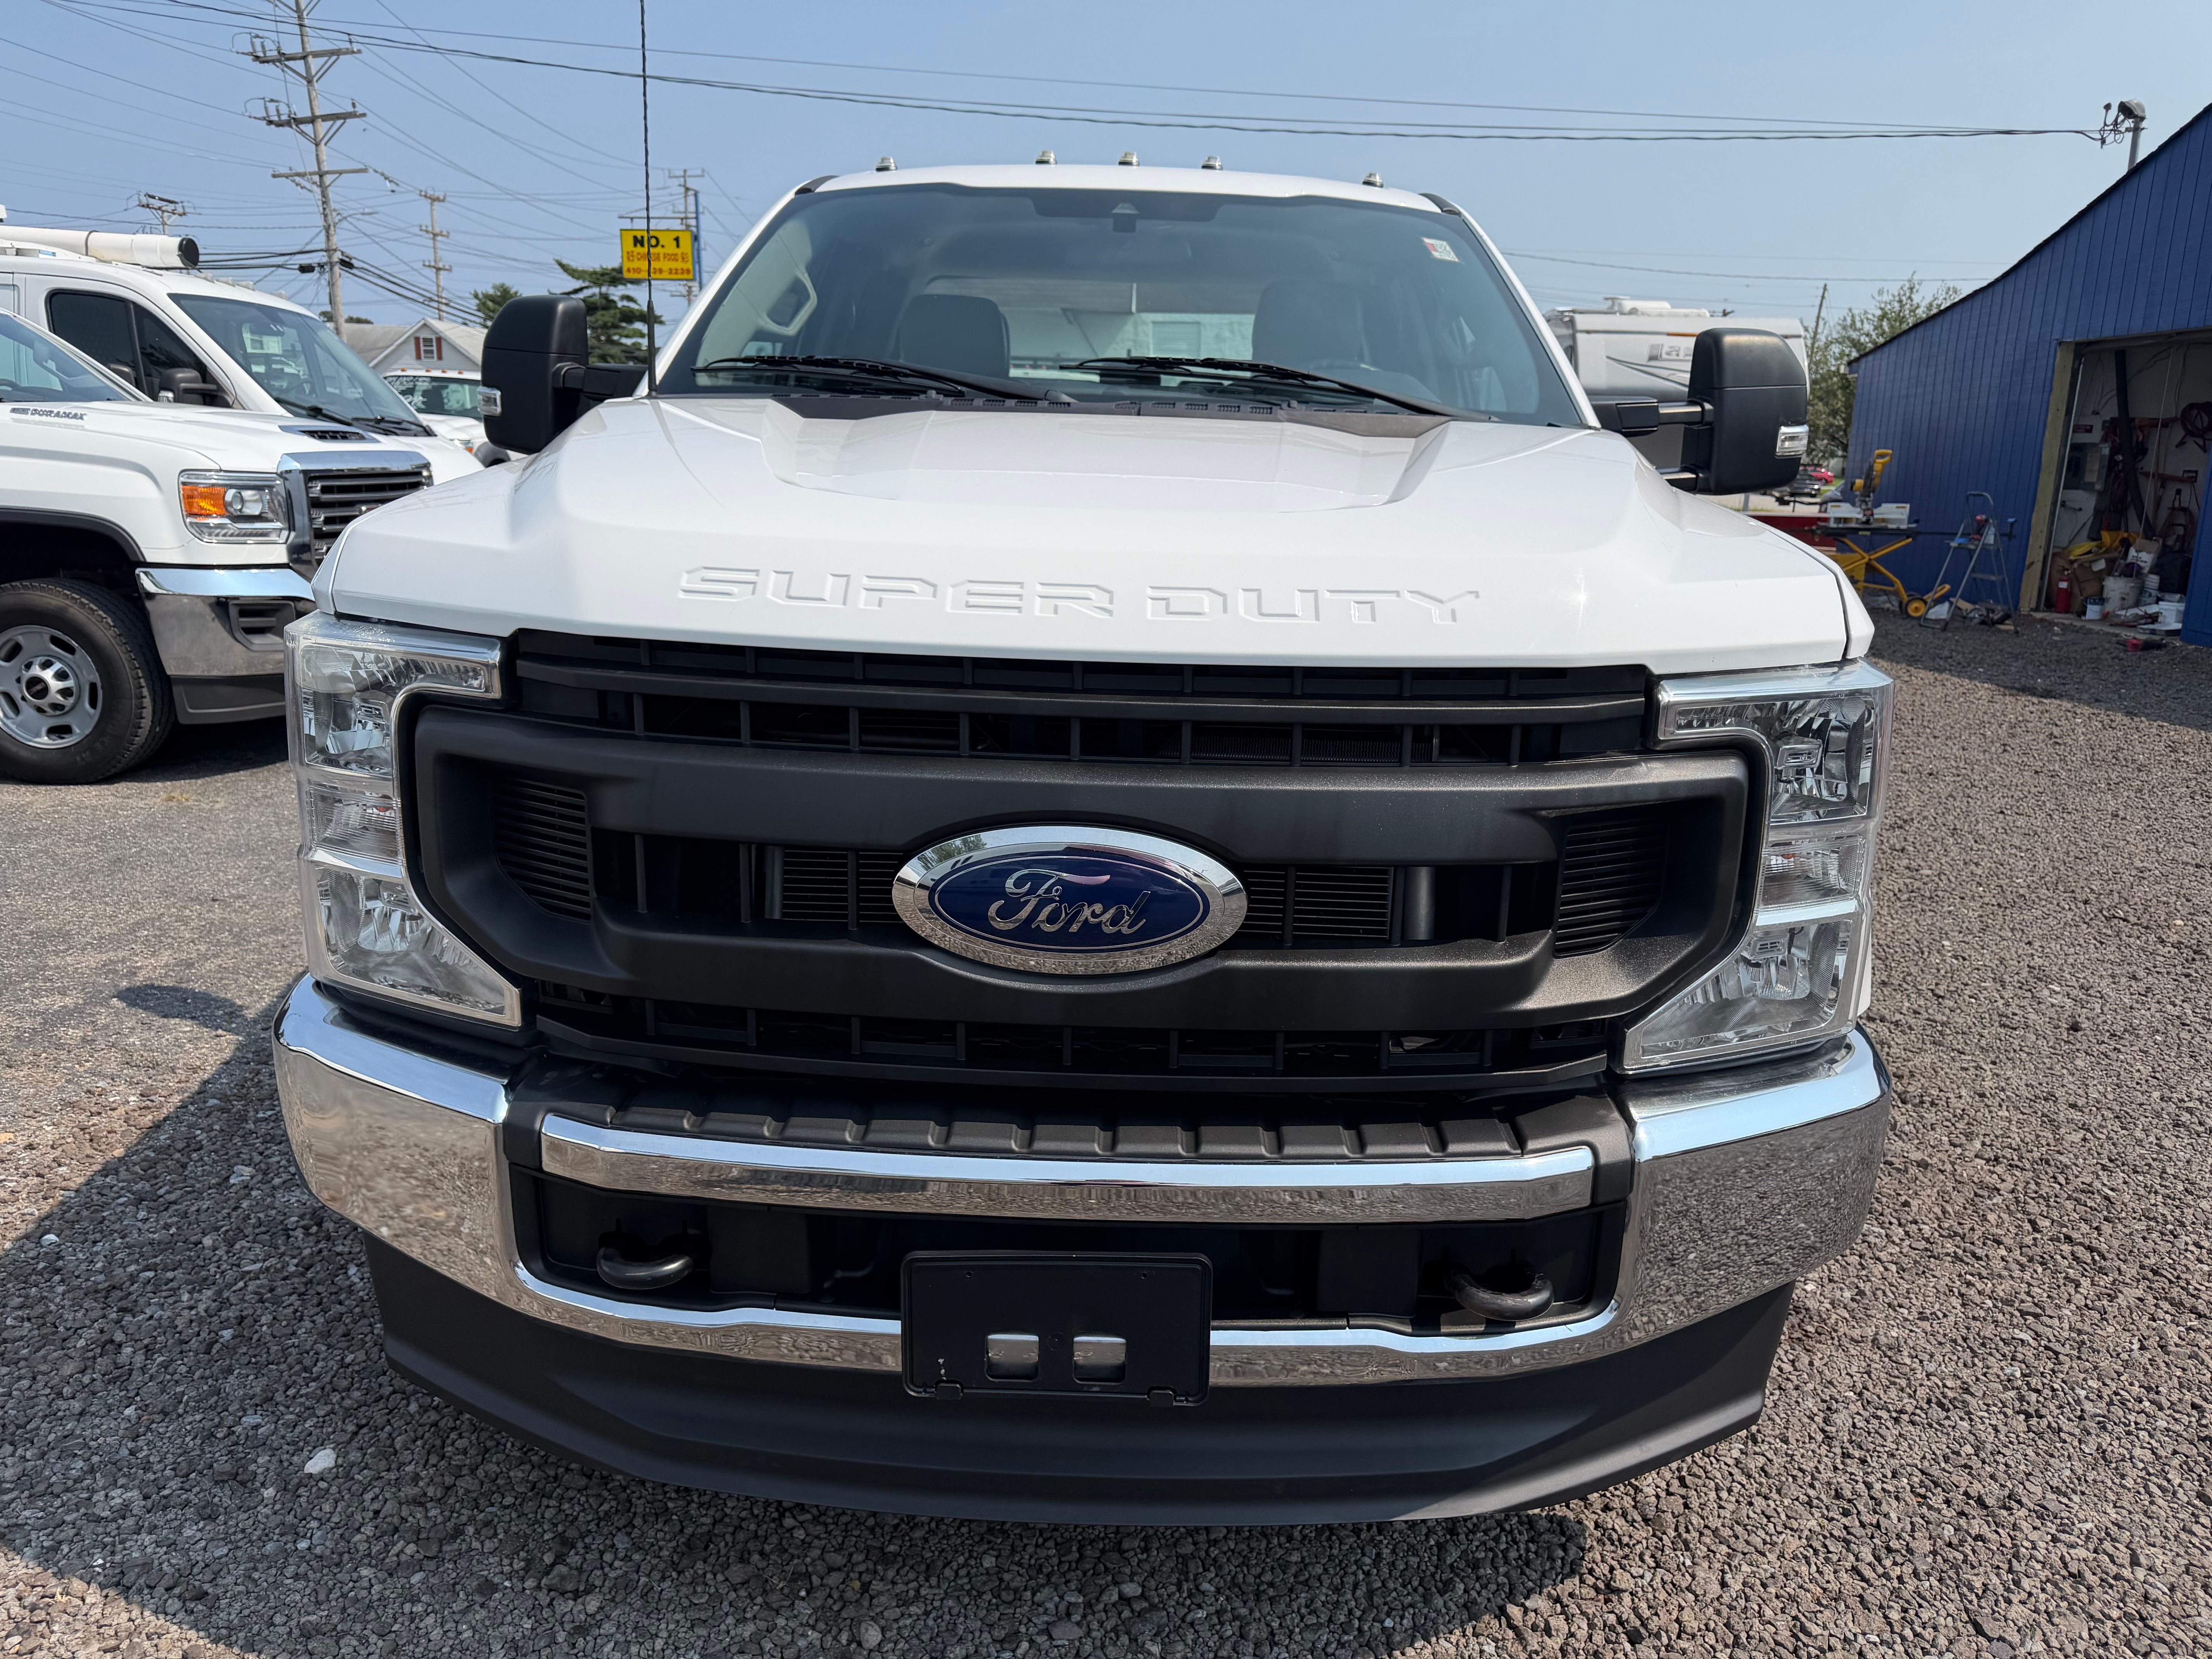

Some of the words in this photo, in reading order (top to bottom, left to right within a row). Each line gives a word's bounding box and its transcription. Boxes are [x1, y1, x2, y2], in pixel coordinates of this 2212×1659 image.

[633, 235, 665, 248] NO.
[673, 236, 680, 249] 1
[30, 408, 88, 421] DURAMAX
[678, 566, 1114, 619] SUPER
[1147, 585, 1479, 624] DUTY
[988, 869, 1151, 934] Ford
